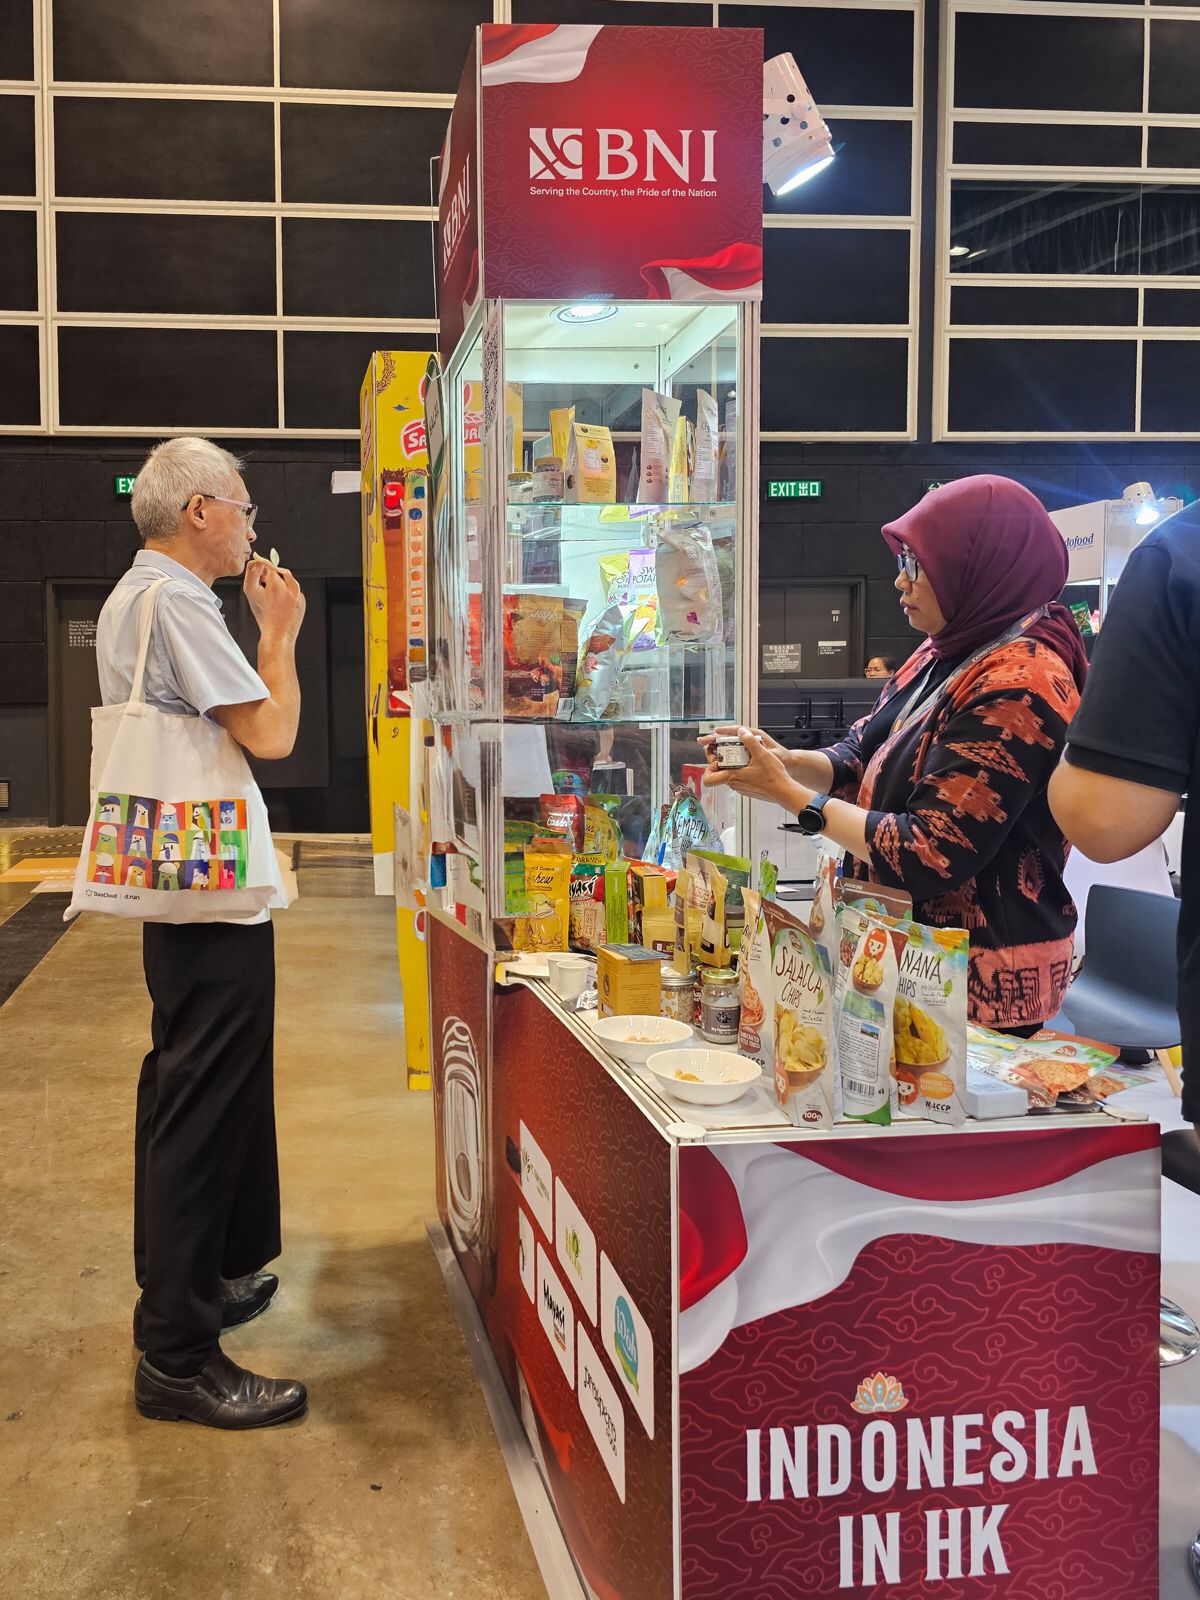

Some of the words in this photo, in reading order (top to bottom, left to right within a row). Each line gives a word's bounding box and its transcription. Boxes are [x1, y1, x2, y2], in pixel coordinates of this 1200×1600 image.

[596, 128, 718, 184] BNI
[452, 152, 470, 249] BNI
[530, 186, 564, 197] Serving
[566, 187, 581, 196] the
[582, 187, 619, 198] Country,
[621, 188, 635, 196] the
[637, 188, 660, 197] Pride
[661, 188, 671, 197] of
[672, 188, 686, 197] the
[688, 188, 717, 198] Nation
[119, 478, 135, 493] EX
[771, 482, 796, 497] EXIT
[798, 482, 819, 497] 出口
[775, 945, 822, 994] SALACCA
[901, 950, 942, 985] NANA
[781, 981, 802, 1009] CHIPS
[897, 976, 917, 998] HIPS
[746, 1405, 1098, 1502] INDONESIA
[838, 1512, 901, 1589] IN
[924, 1503, 1011, 1582] HK
